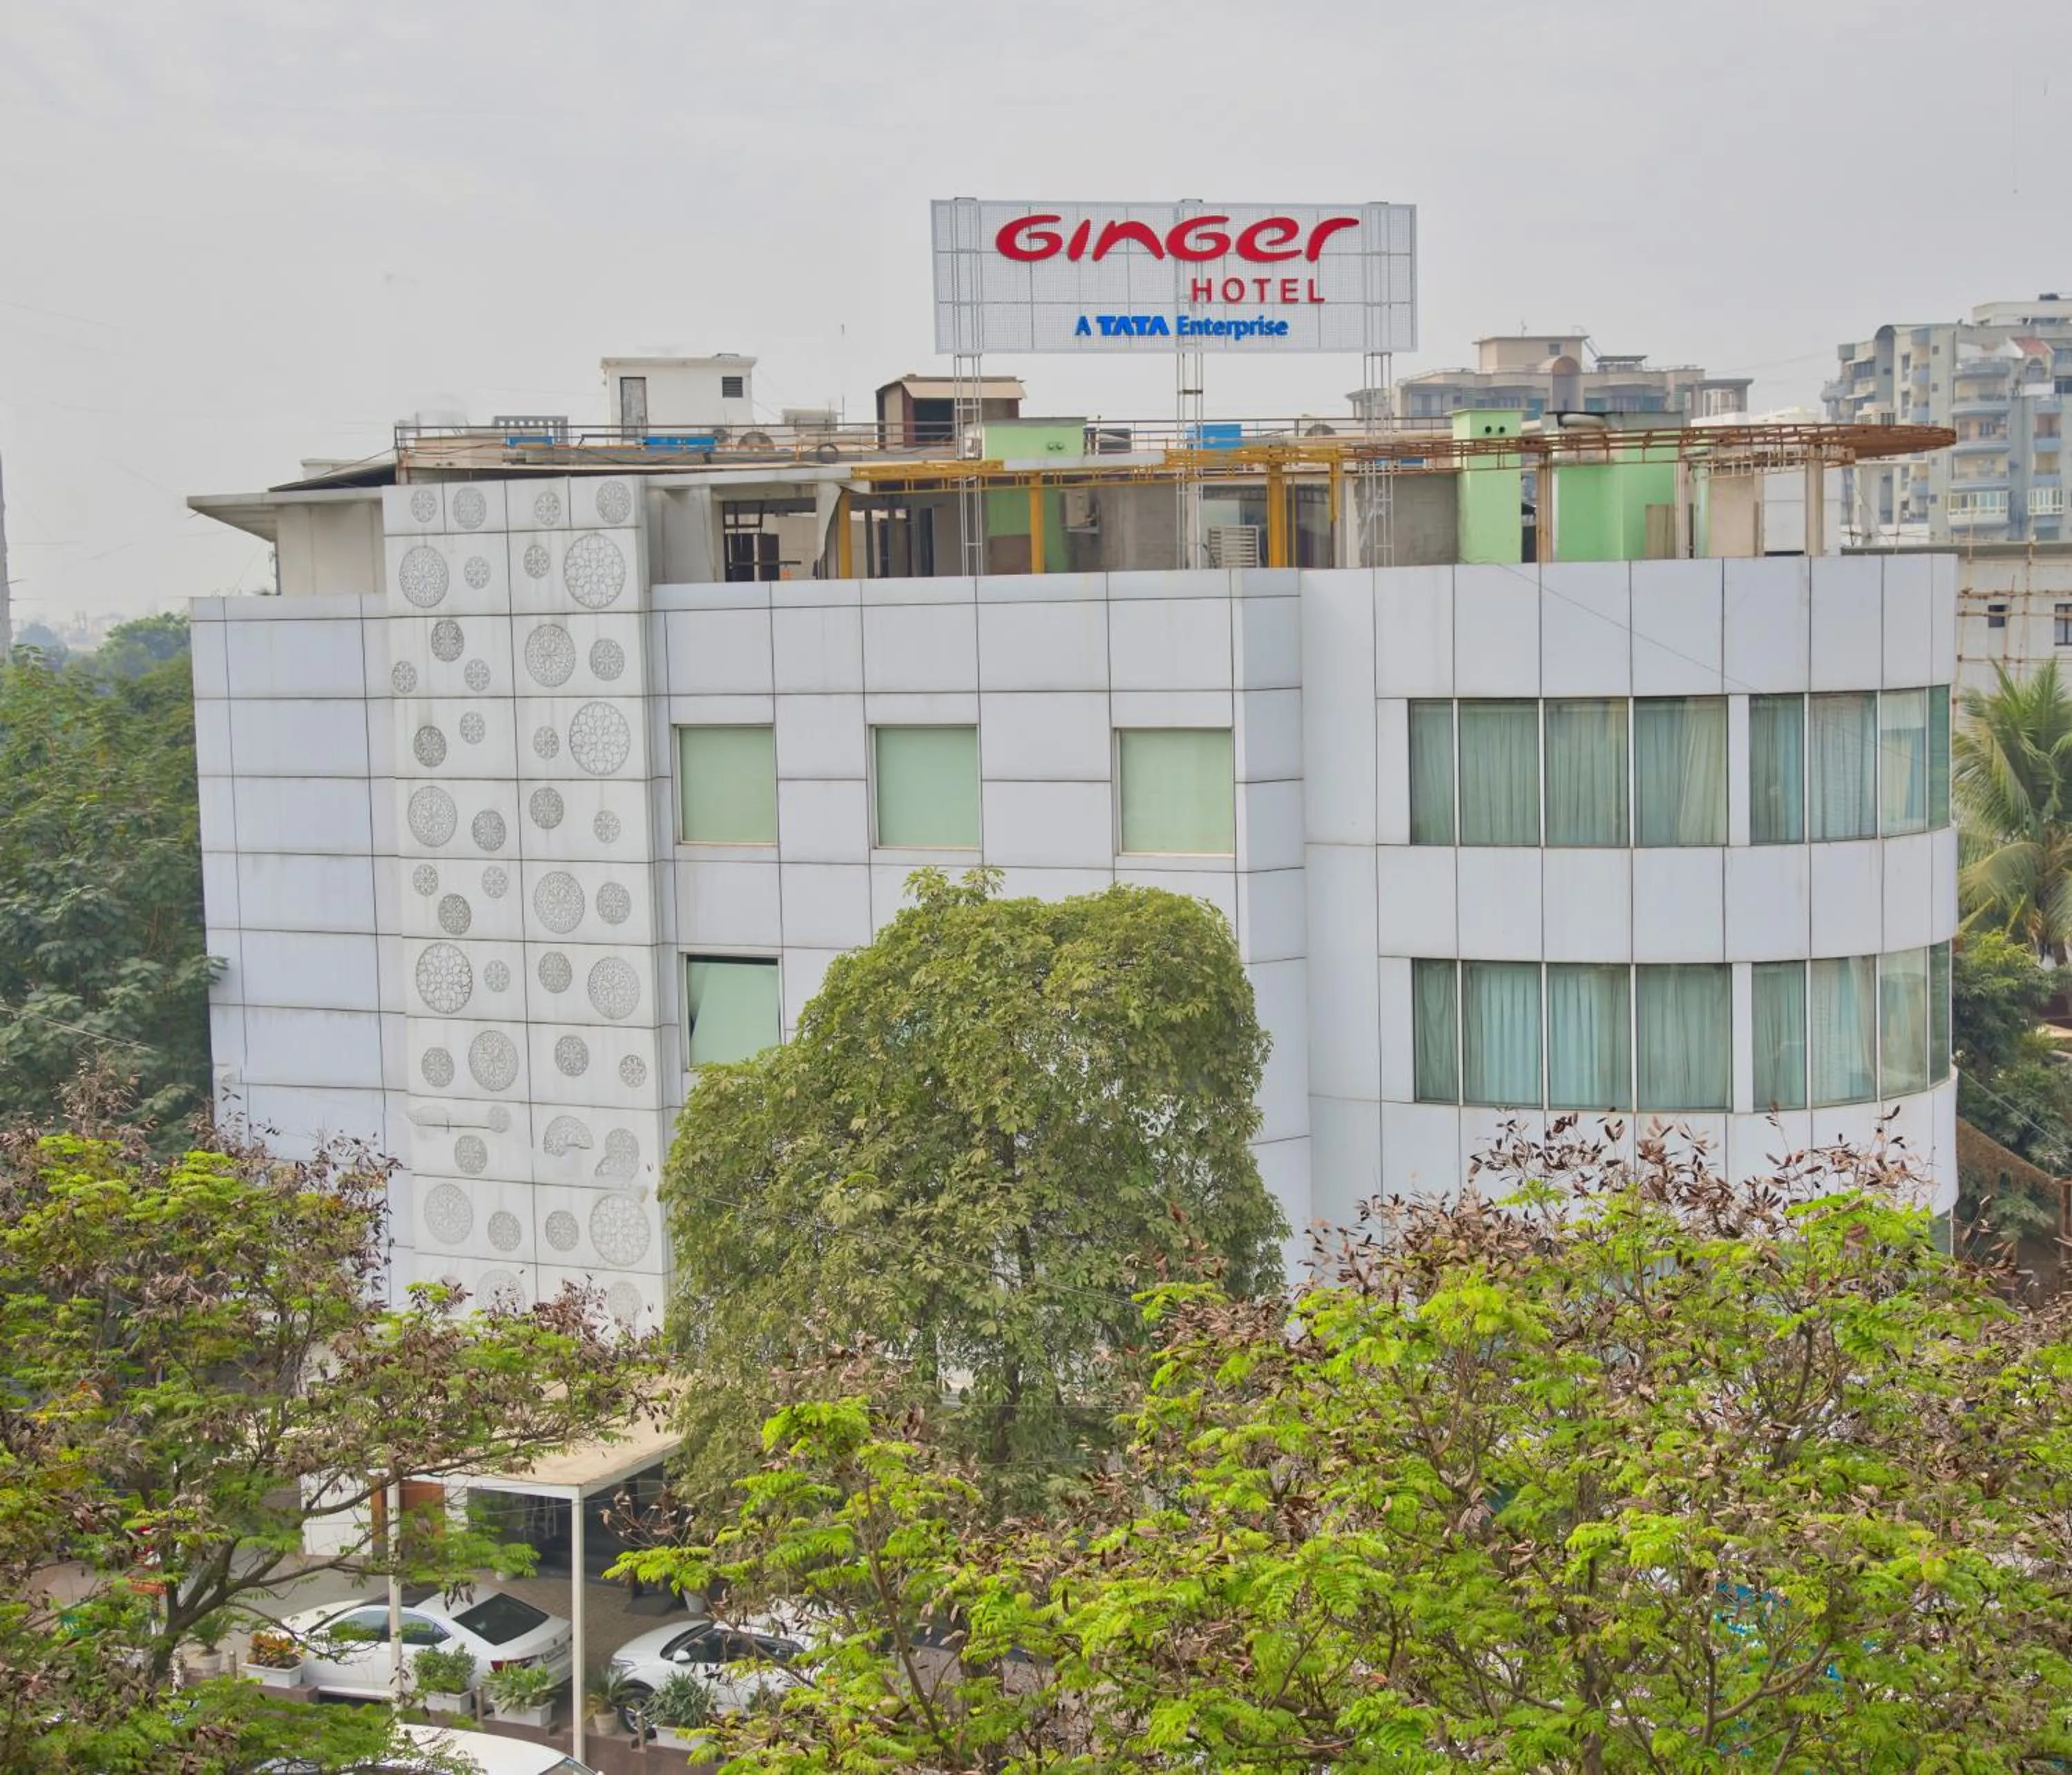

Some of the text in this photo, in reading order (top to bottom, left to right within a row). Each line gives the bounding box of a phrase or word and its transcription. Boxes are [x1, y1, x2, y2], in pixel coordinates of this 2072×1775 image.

[1191, 278, 1325, 304] HOTEL
[1075, 314, 1289, 340] A TATA Enterprise
